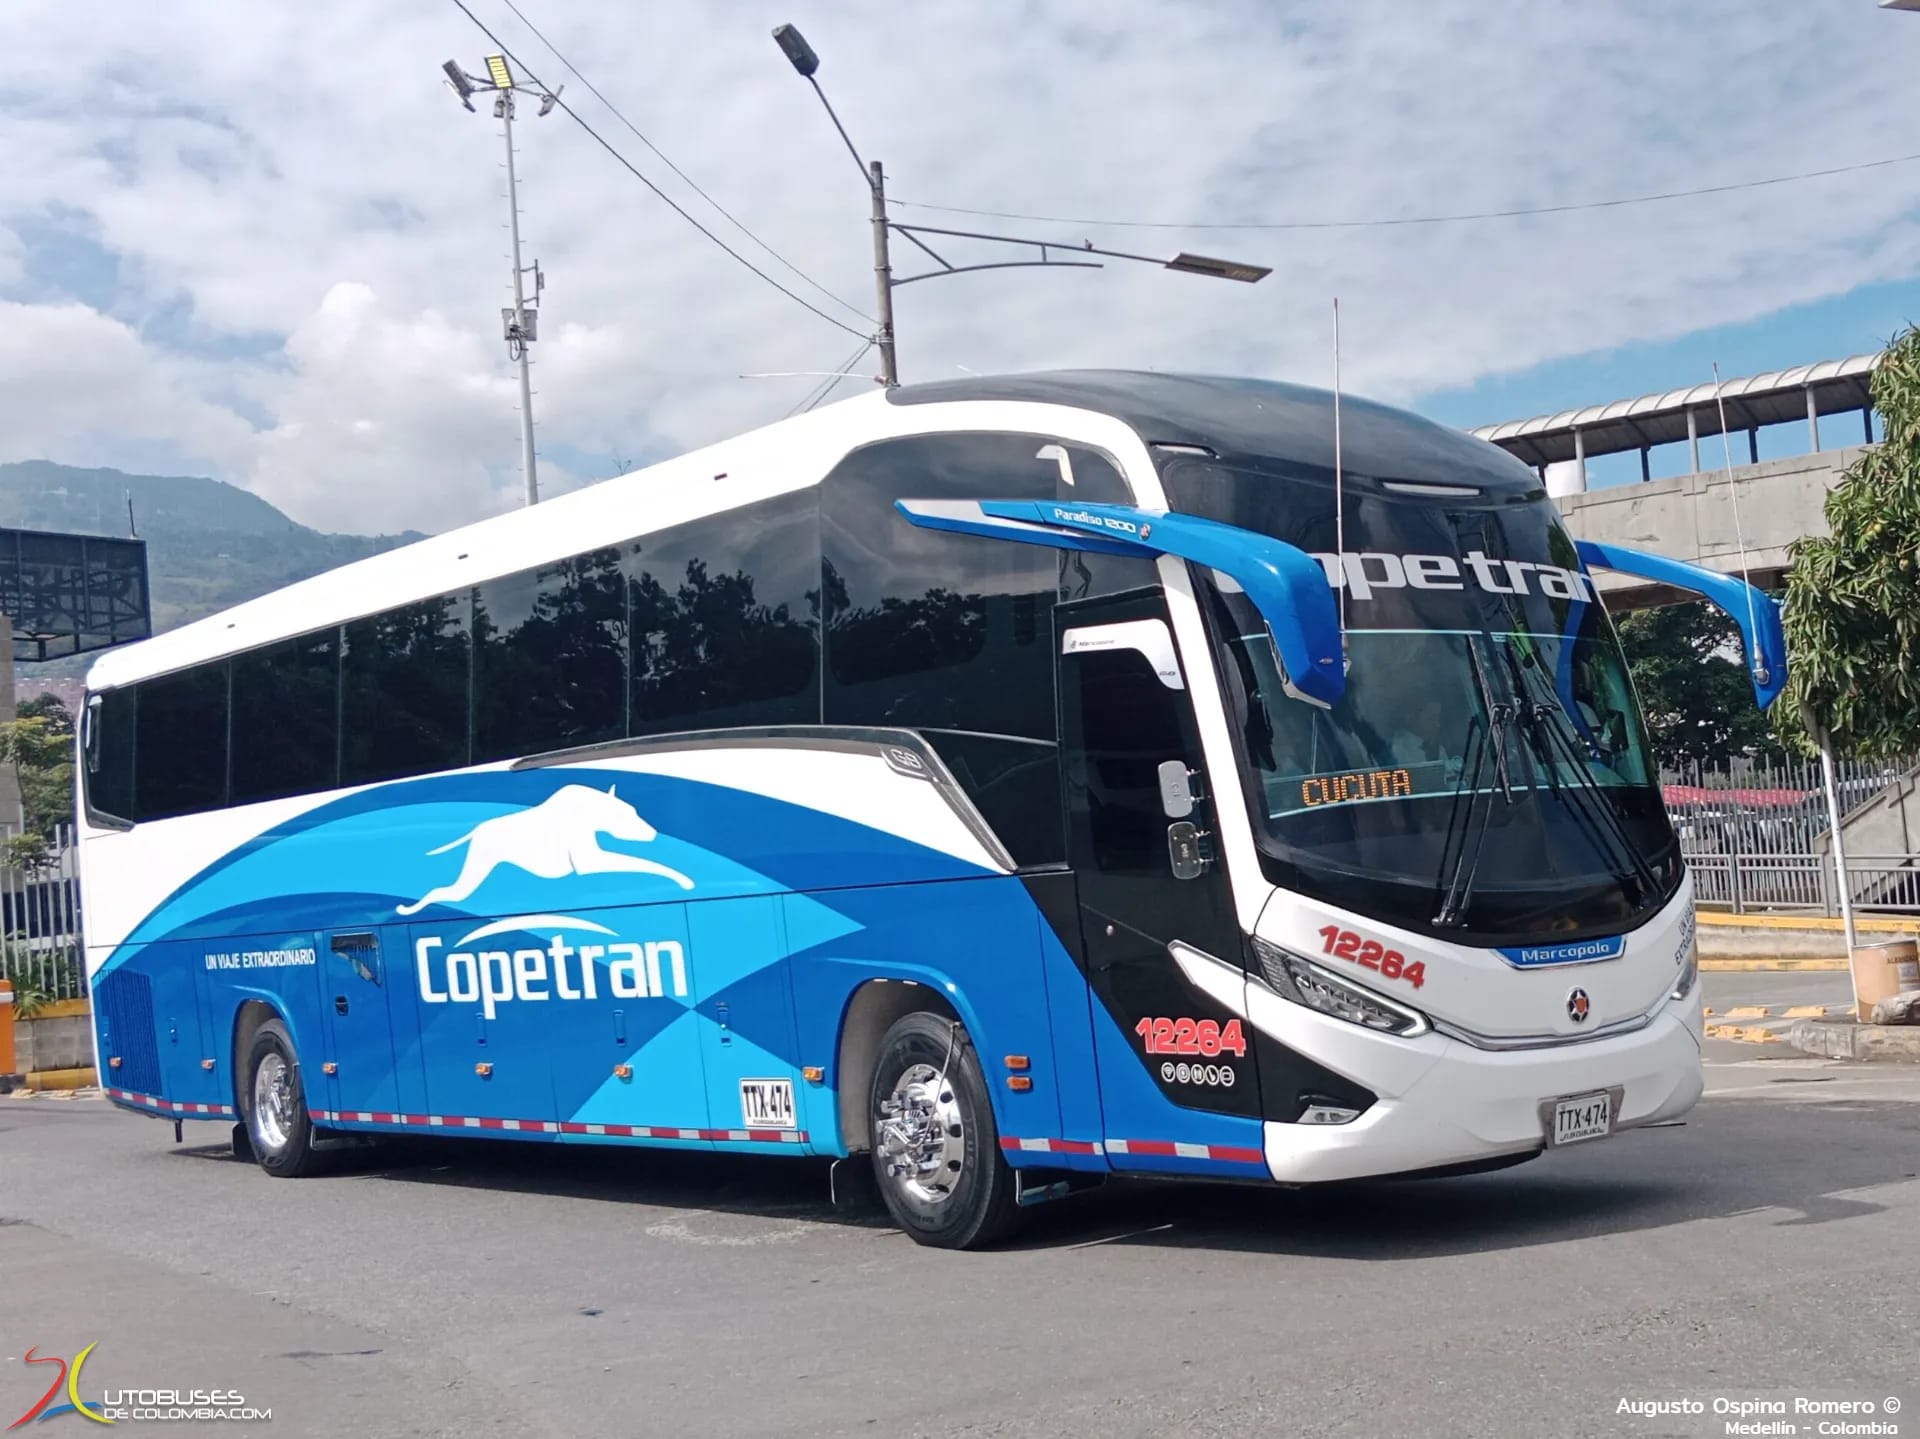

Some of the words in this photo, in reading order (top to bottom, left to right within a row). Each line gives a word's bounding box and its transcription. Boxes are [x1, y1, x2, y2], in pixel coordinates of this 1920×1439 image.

[1054, 508, 1102, 526] Paradiso
[1103, 518, 1136, 534] 1200
[1302, 769, 1411, 806] CUCUTA
[205, 954, 217, 970] UN
[217, 952, 240, 969] VIAJE
[242, 948, 316, 968] EXTRAORDINARIO
[1319, 925, 1425, 990] 12264
[1521, 942, 1609, 963] Marcopolo
[416, 934, 688, 1020] Copetran
[1135, 1017, 1246, 1057] 12264
